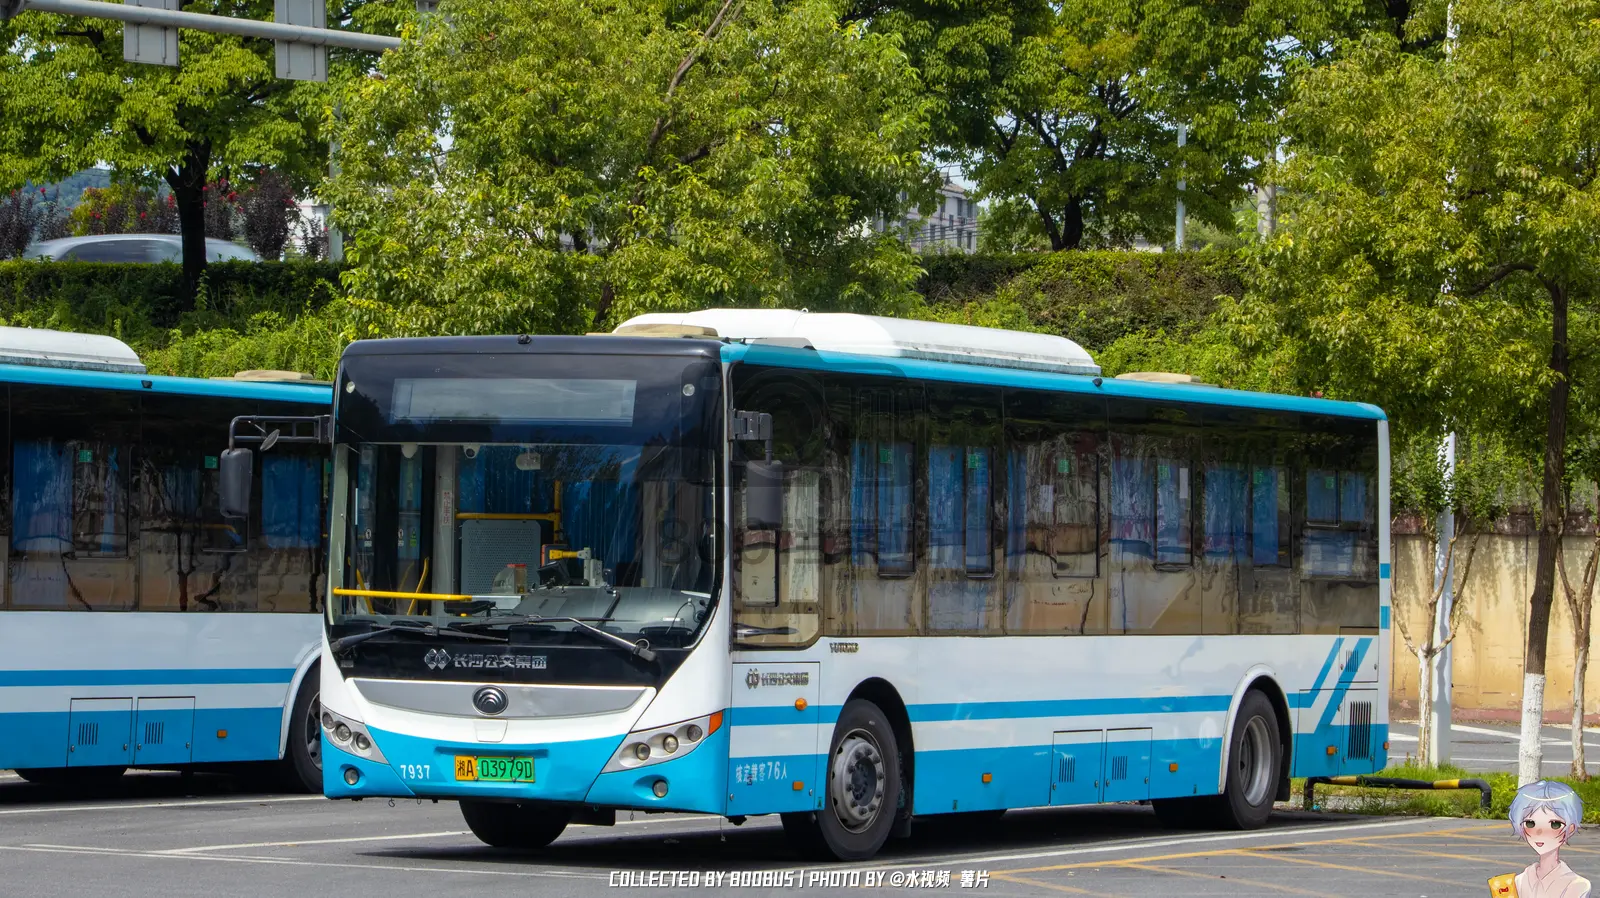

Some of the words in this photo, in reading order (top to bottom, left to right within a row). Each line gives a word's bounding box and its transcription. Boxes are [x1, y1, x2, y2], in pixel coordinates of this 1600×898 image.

[453, 653, 547, 669] 长沙公交集团
[400, 764, 430, 779] 7937
